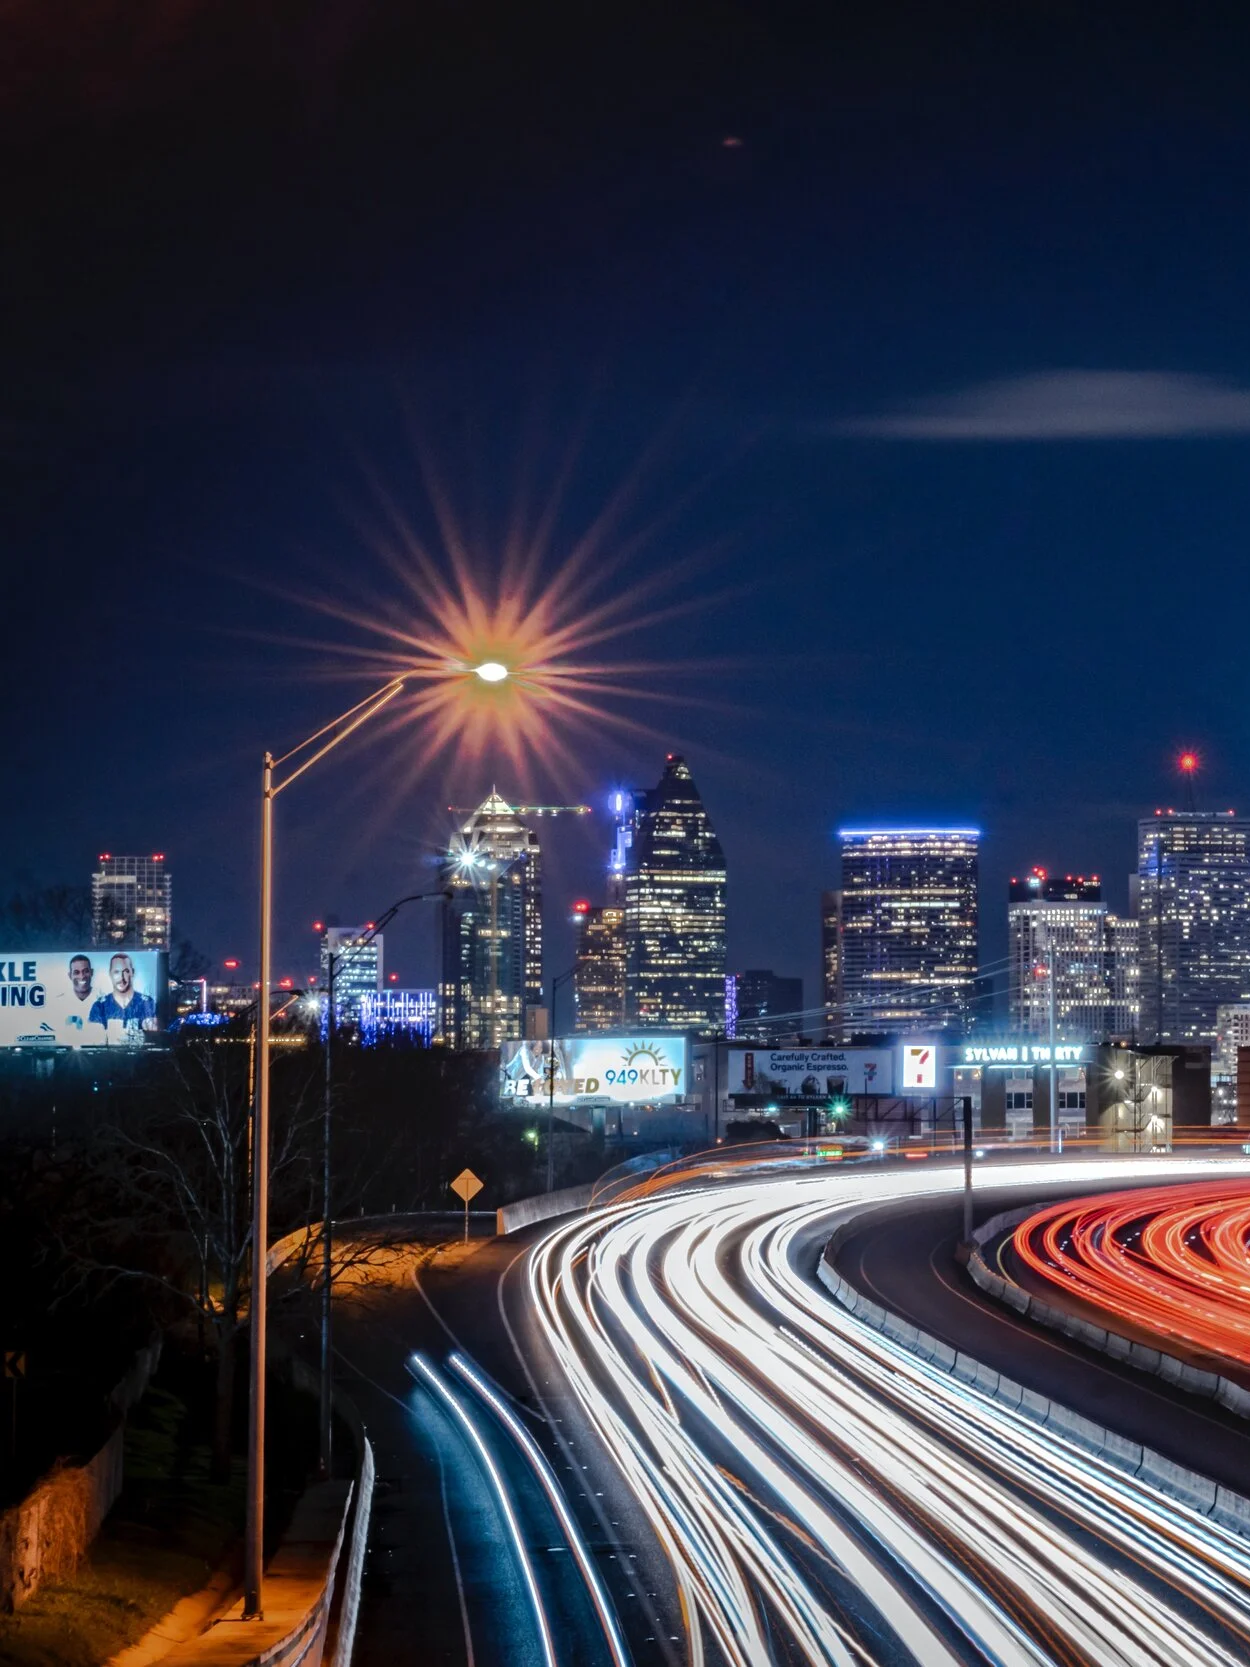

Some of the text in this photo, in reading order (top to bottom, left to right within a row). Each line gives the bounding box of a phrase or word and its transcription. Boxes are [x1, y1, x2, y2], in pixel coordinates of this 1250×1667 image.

[1, 985, 45, 1007] ING
[770, 1053, 846, 1063] Carefully Crafted.
[965, 1046, 1018, 1062] SYLVAN
[1031, 1046, 1083, 1061] THRTY
[770, 1062, 849, 1073] Organic Espresso.
